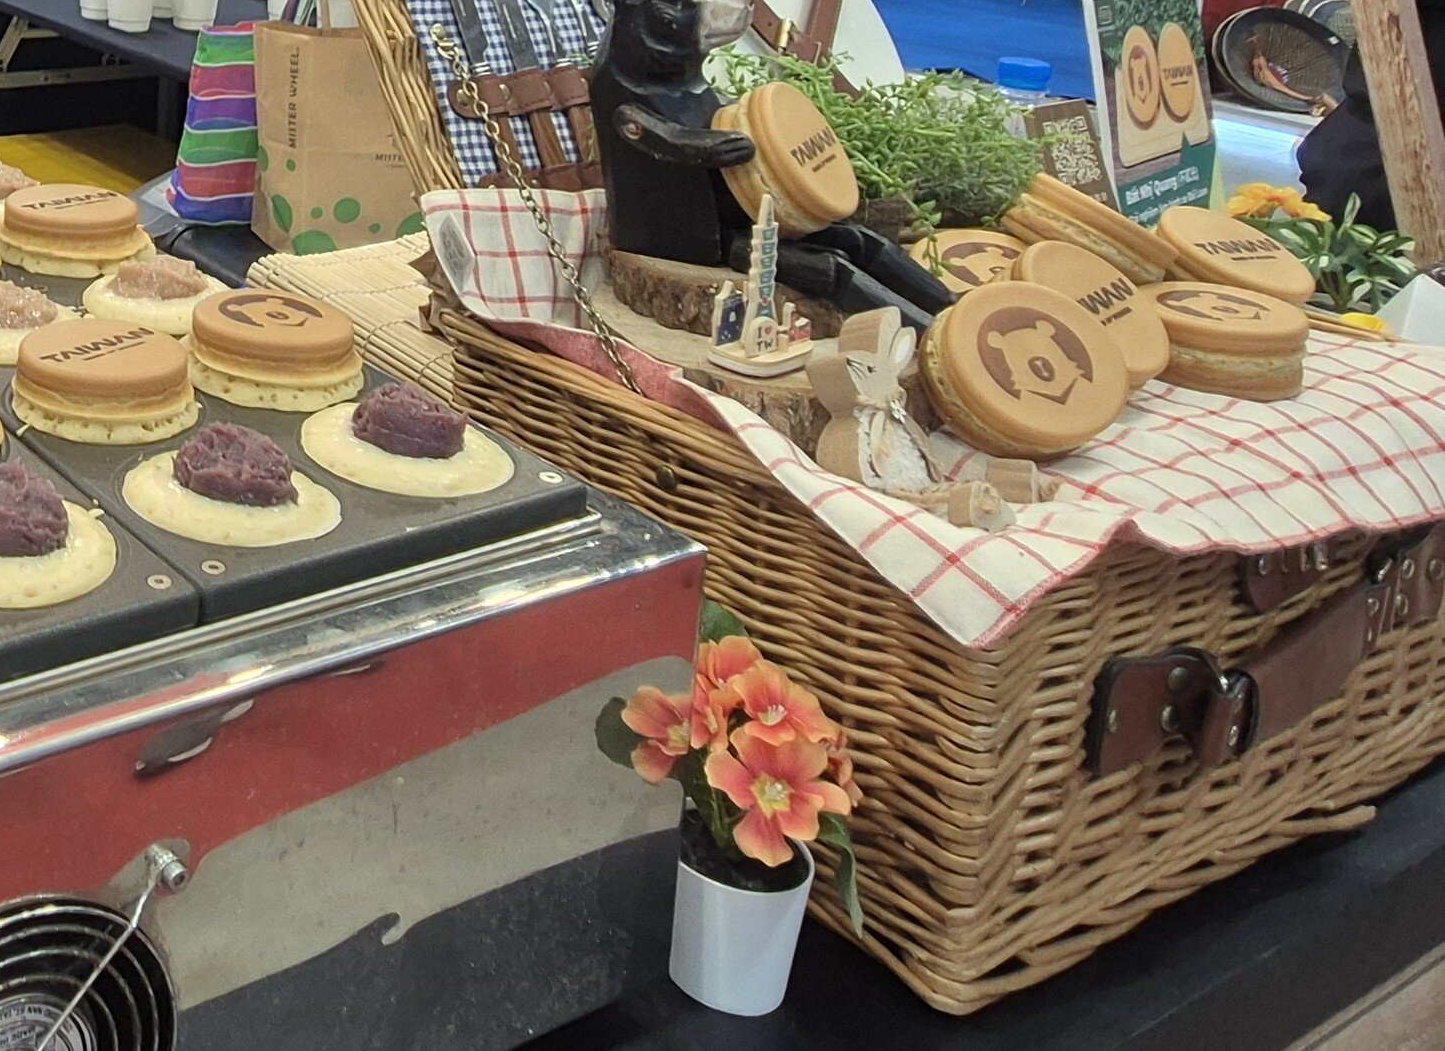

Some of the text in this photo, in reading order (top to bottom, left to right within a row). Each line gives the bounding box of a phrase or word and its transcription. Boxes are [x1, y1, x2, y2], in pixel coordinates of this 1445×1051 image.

[287, 47, 300, 149] MISTER WHEEL
[789, 126, 837, 168] TAIWAN
[374, 153, 403, 162] MISTE
[20, 190, 119, 210] TAIWAN
[1193, 237, 1282, 256] TAIWAN
[38, 326, 156, 364] TAIWAN
[756, 338, 774, 352] TW
[10, 1028, 36, 1042] MADE
